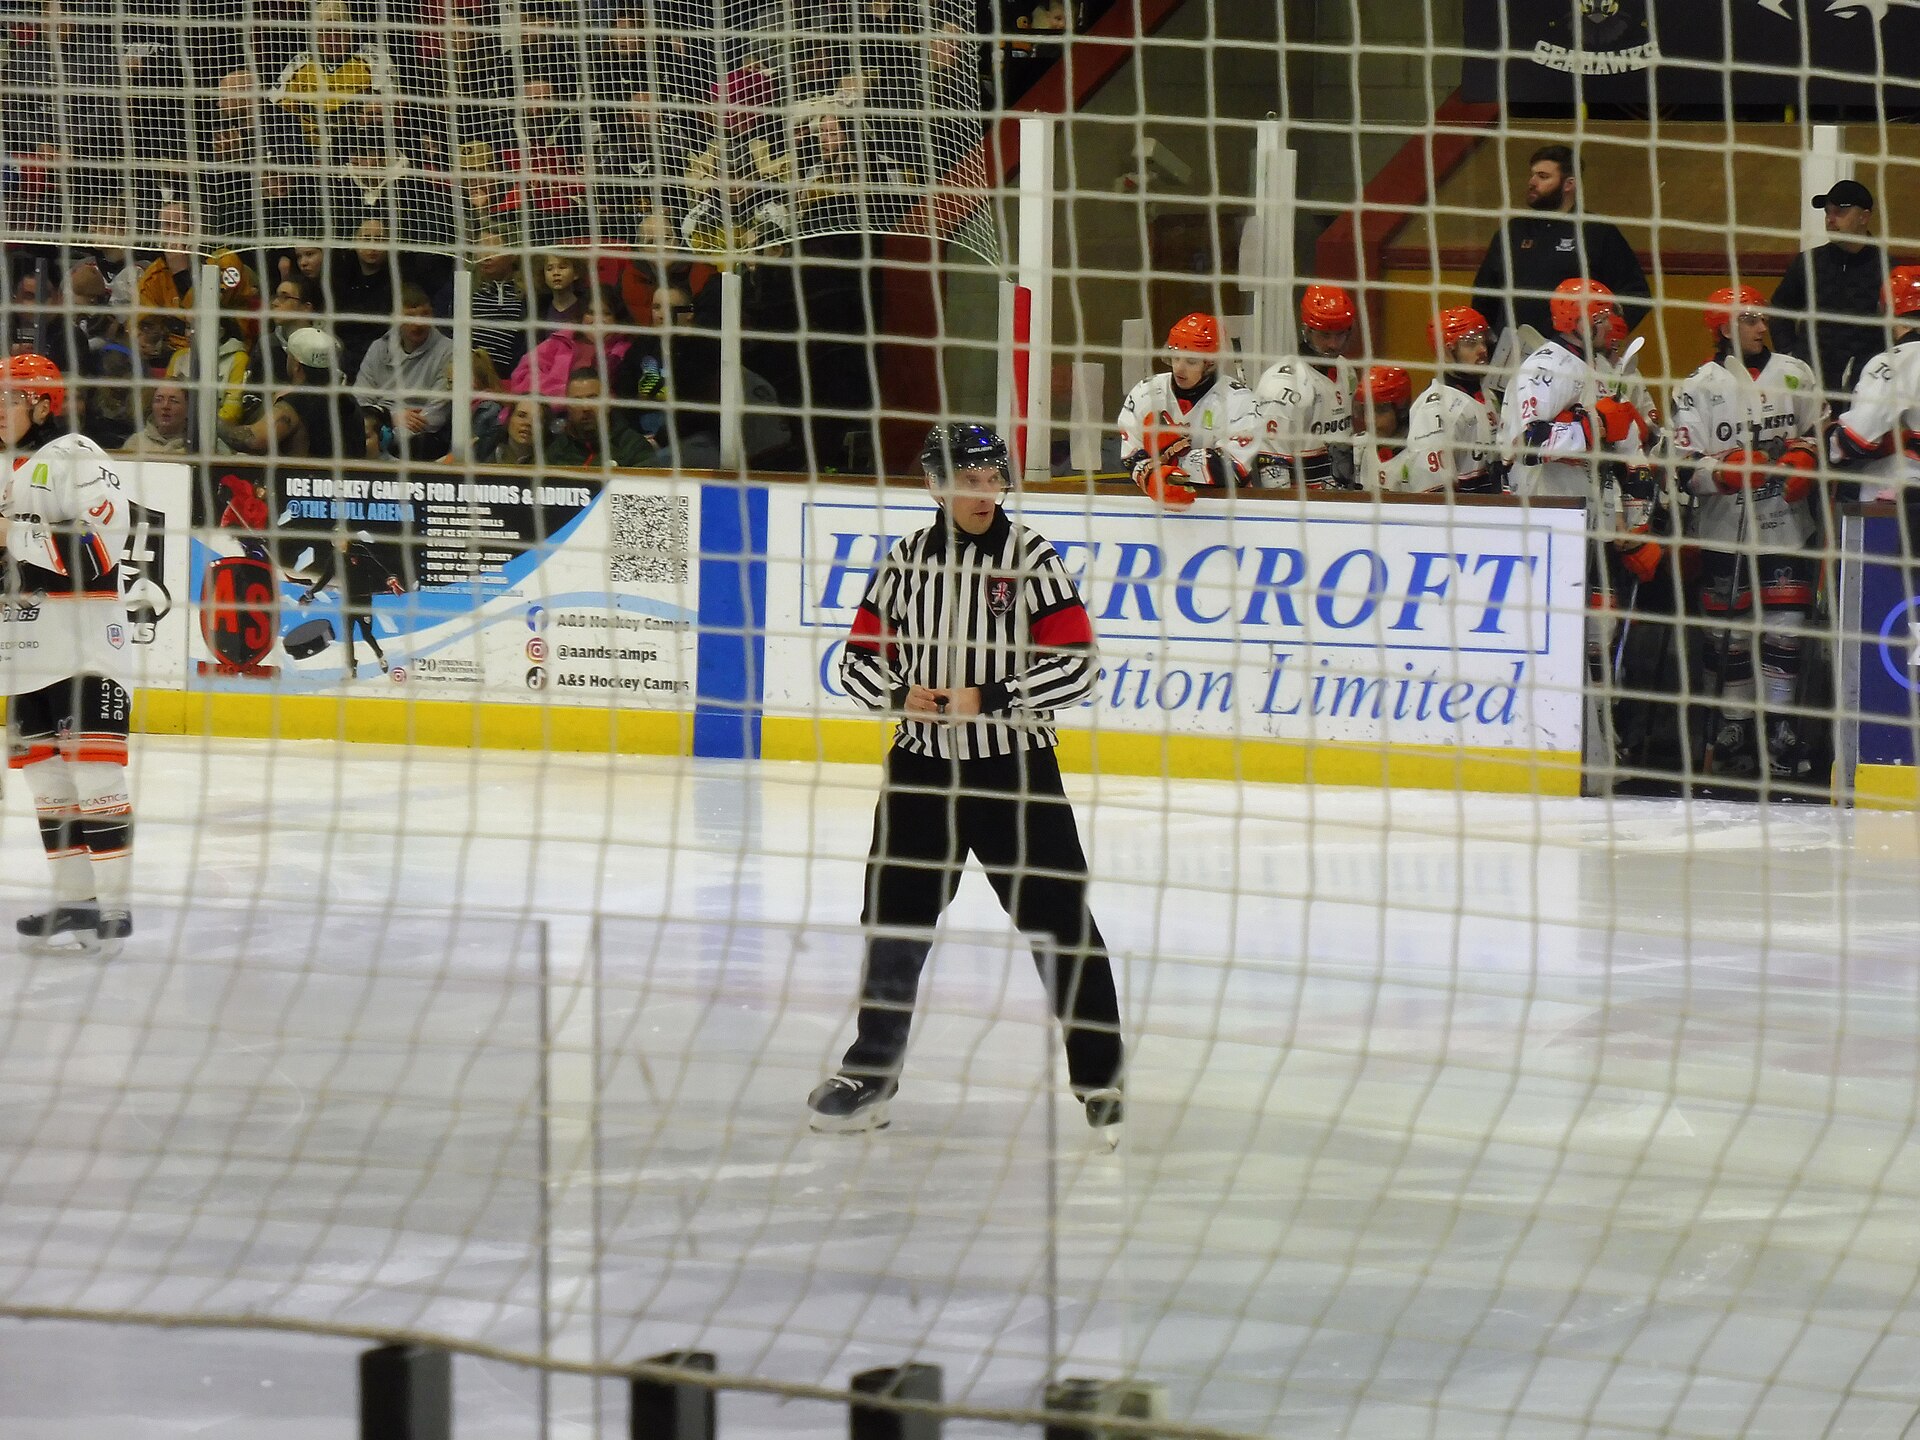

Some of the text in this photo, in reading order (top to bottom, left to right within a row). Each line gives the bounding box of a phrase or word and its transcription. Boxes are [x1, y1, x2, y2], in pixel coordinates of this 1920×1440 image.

[286, 478, 591, 507] ICE HOCKEY CAMPS FOR JUNIORS & ADULTS
[813, 533, 1538, 634] HERCROFT
[557, 673, 586, 687] A&S
[589, 675, 640, 691] Hockey
[1255, 653, 1526, 726] Limited
[112, 685, 125, 722] one
